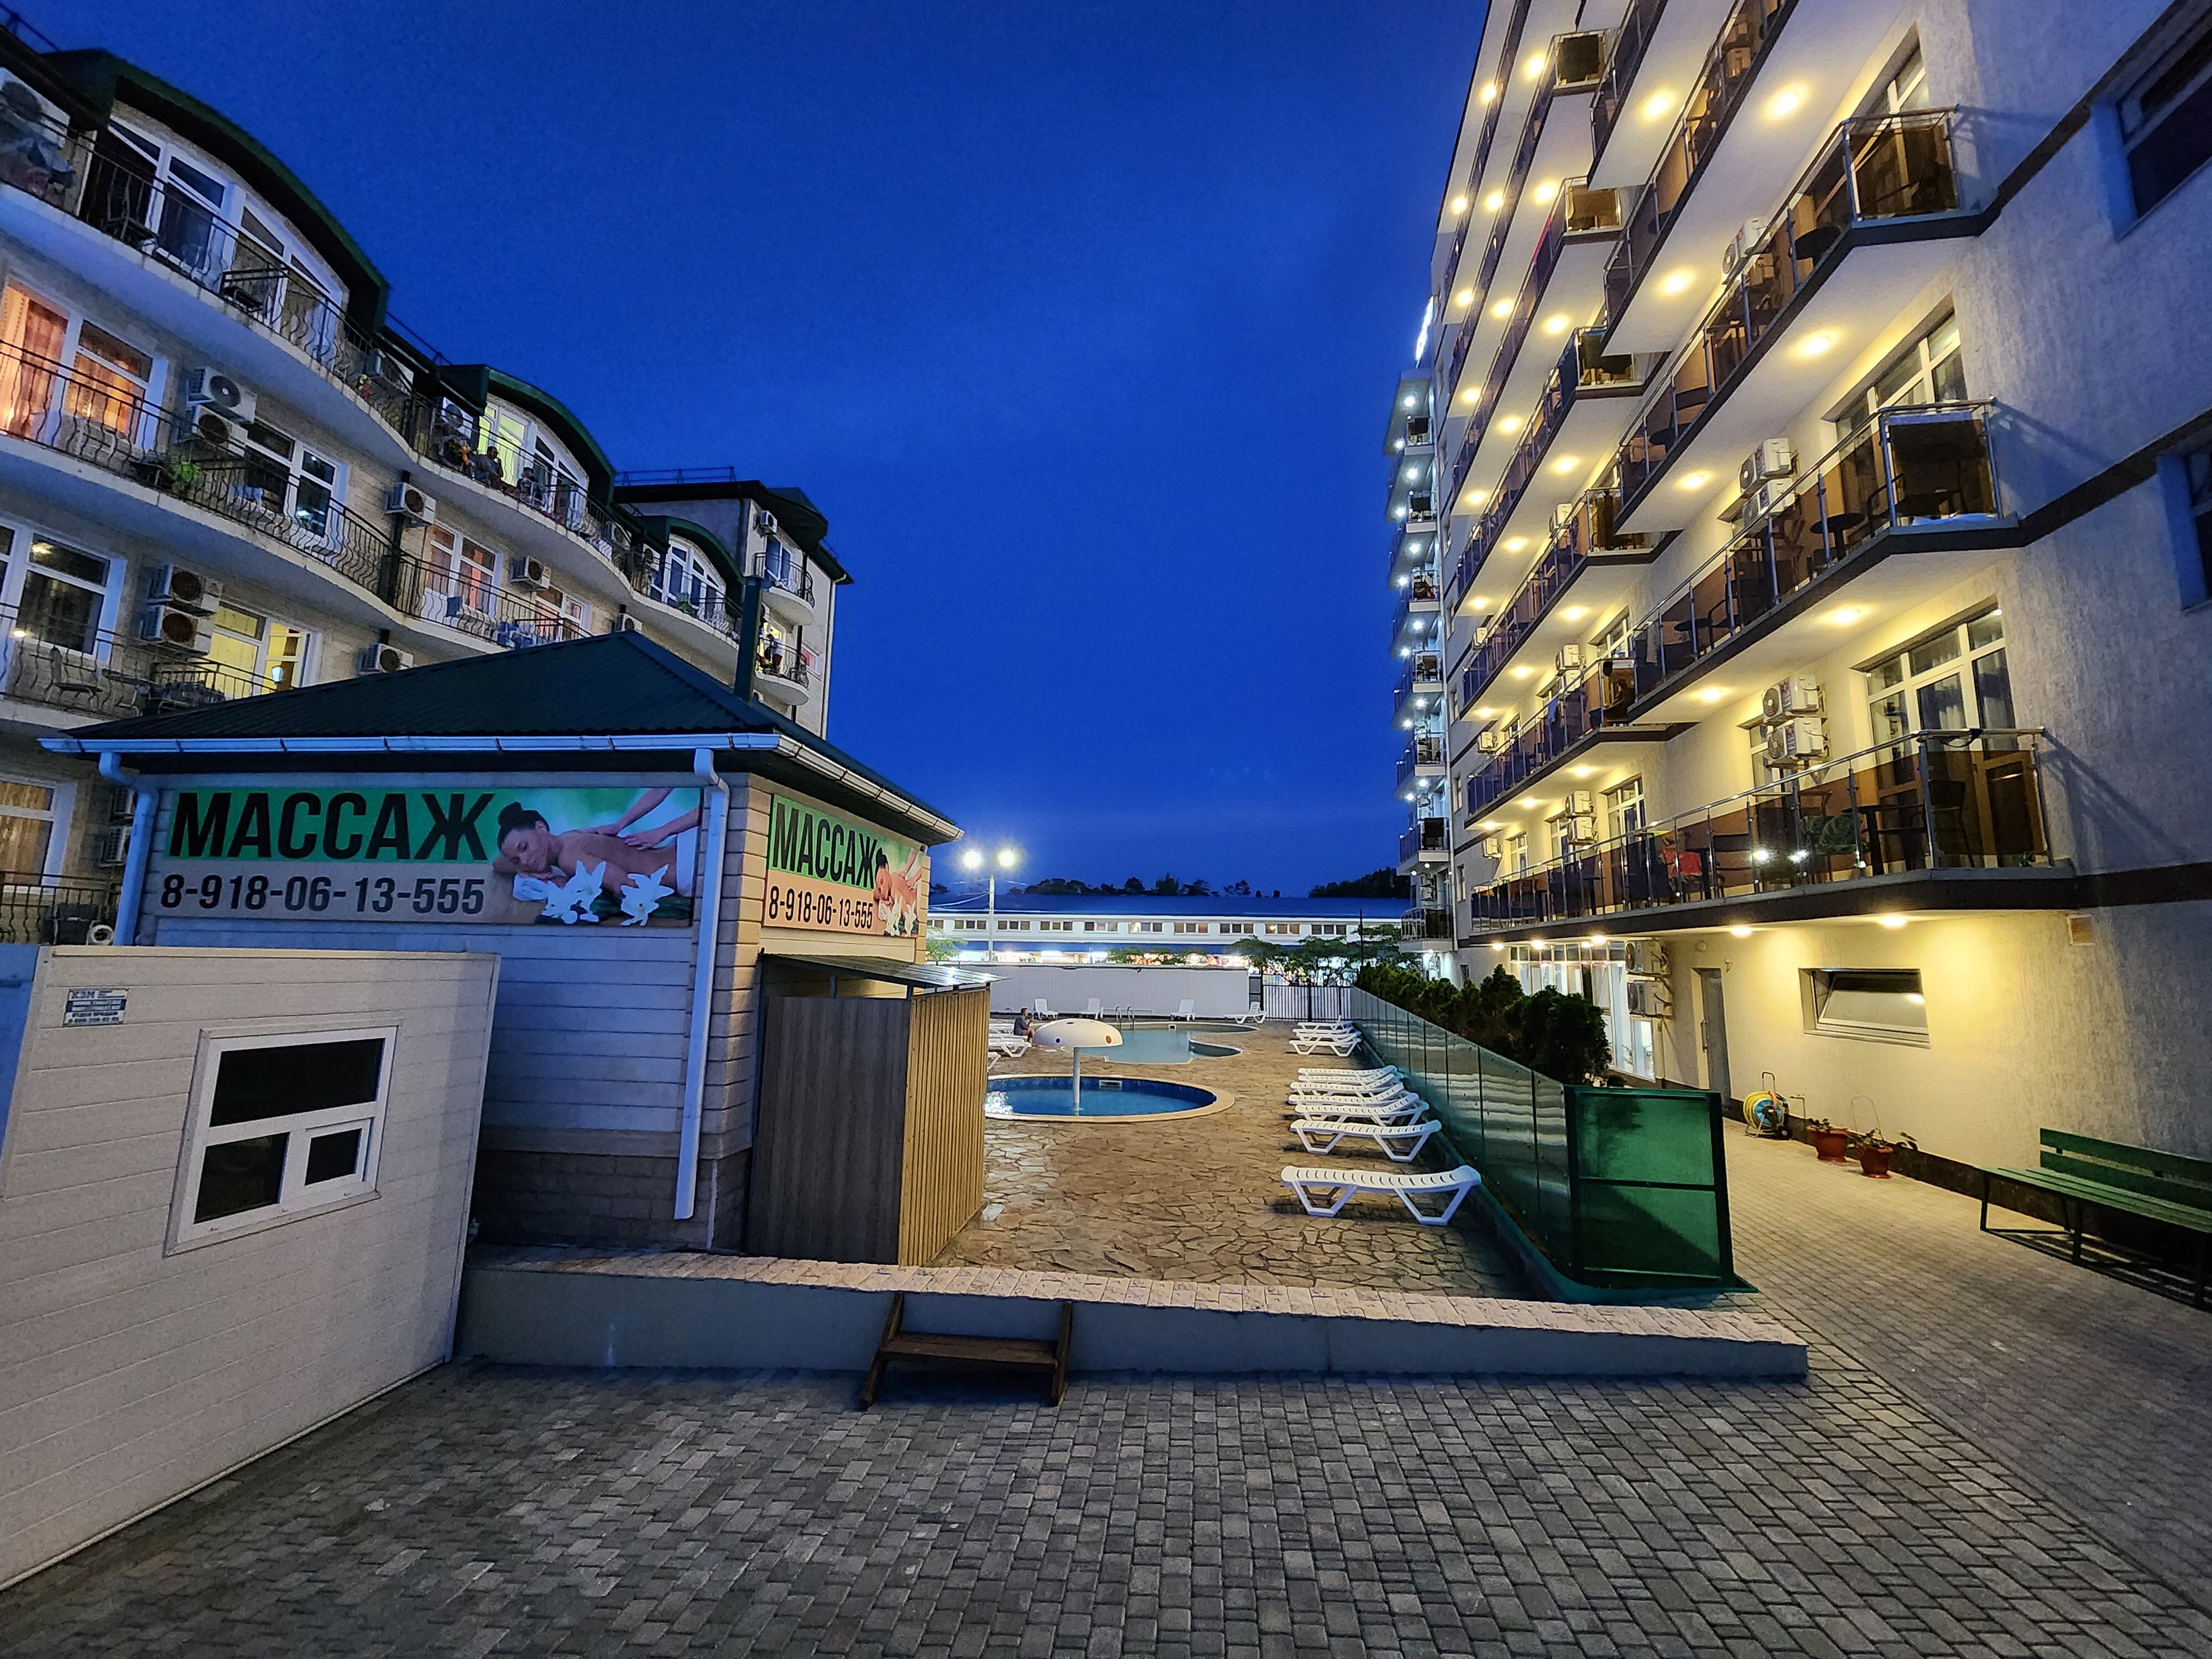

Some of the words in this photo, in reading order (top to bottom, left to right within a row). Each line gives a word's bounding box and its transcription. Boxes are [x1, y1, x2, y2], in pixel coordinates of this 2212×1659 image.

[169, 792, 494, 860] МАССАЖ
[772, 802, 877, 889] МАССАЖ
[161, 874, 484, 914] 8-918-06-13-555
[769, 885, 874, 930] 8-918-06-13-555
